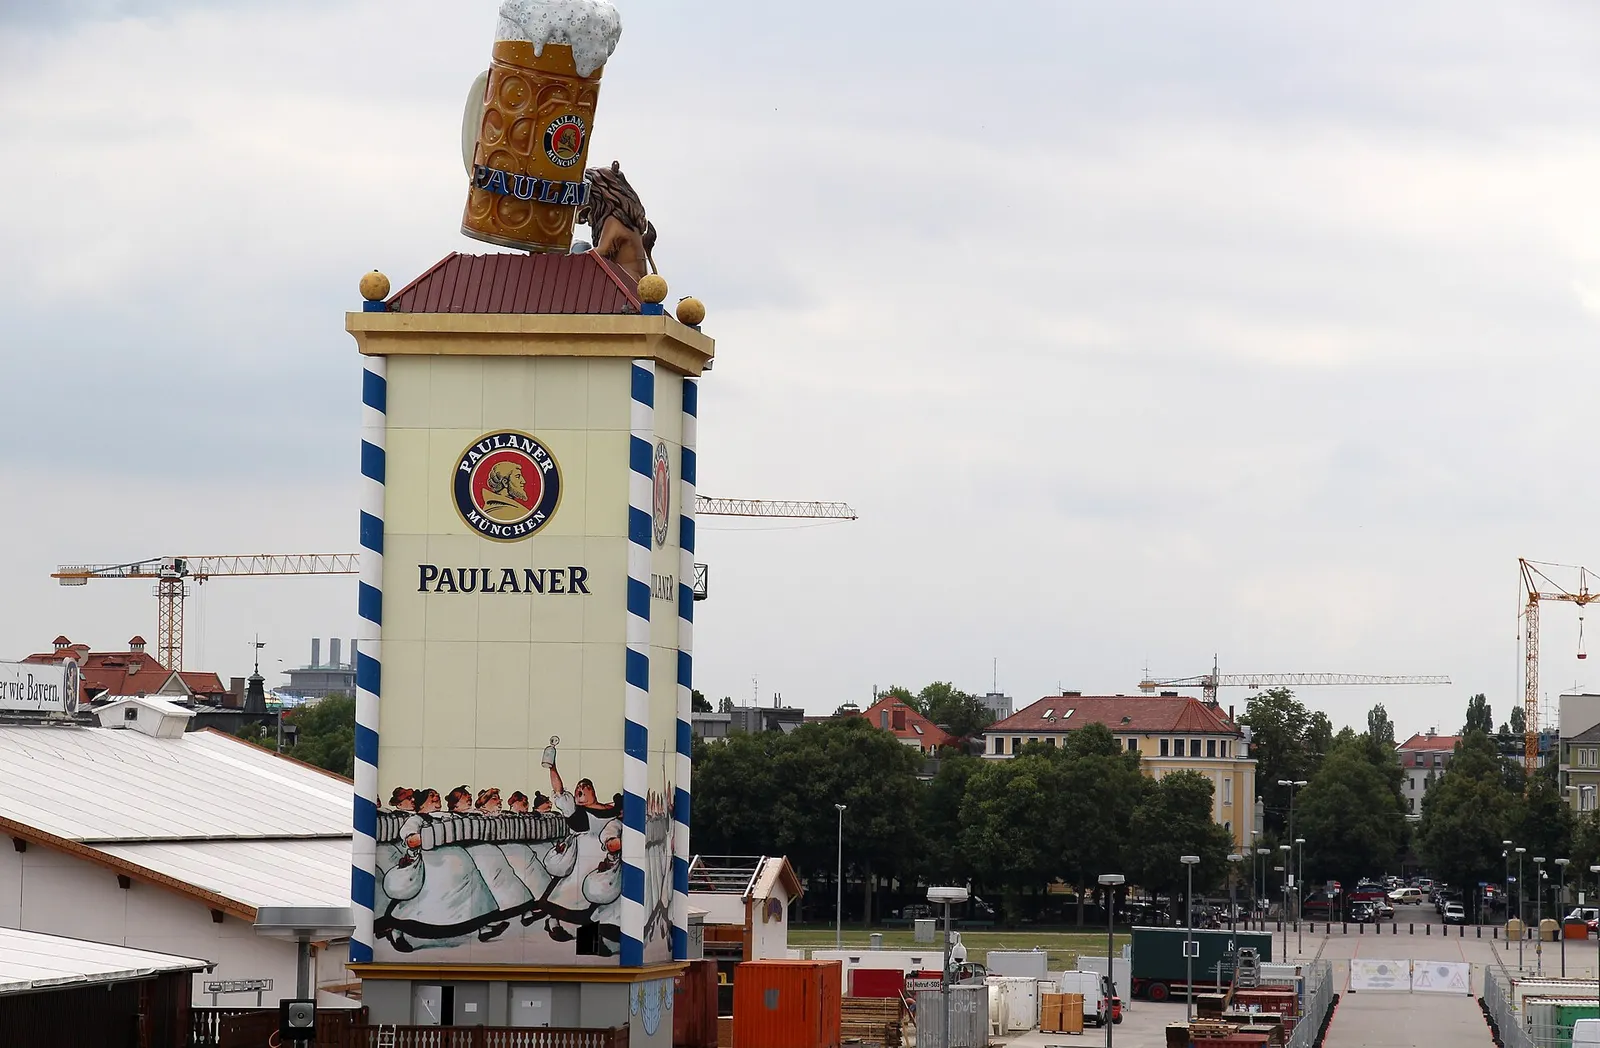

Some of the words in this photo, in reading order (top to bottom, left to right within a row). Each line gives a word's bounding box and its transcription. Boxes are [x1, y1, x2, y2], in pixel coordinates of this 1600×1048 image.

[547, 115, 586, 137] PAULANER
[460, 435, 554, 474] PAULANER
[466, 509, 546, 536] MÜNCHEN
[417, 564, 591, 595] PAULANER
[9, 672, 25, 700] wie
[27, 673, 60, 710] Bayern.
